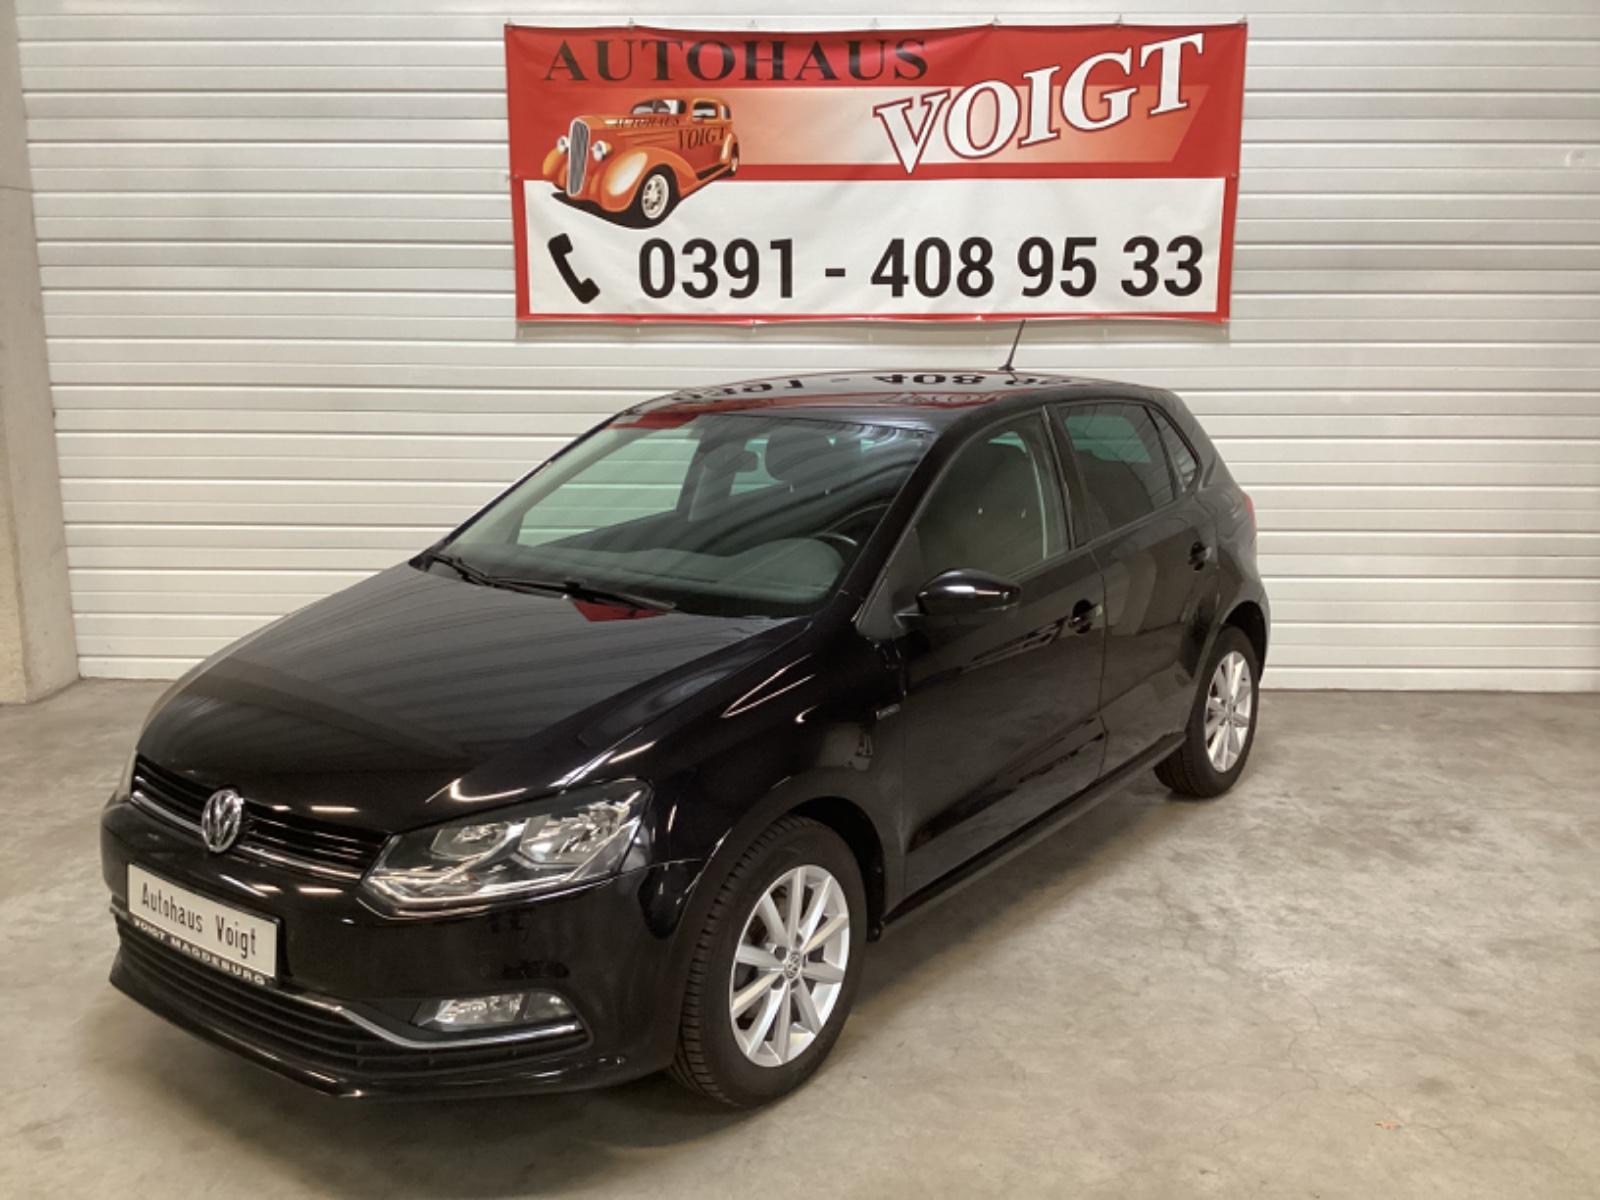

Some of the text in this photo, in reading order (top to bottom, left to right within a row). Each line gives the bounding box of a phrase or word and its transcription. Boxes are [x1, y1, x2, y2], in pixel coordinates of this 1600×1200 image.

[543, 38, 928, 83] AUTOHAUS
[873, 32, 1205, 174] VOIGT
[677, 126, 726, 150] VOIGT
[638, 235, 1203, 299] 0391 - 408 95 33
[142, 882, 256, 960] Autohaus Voigt
